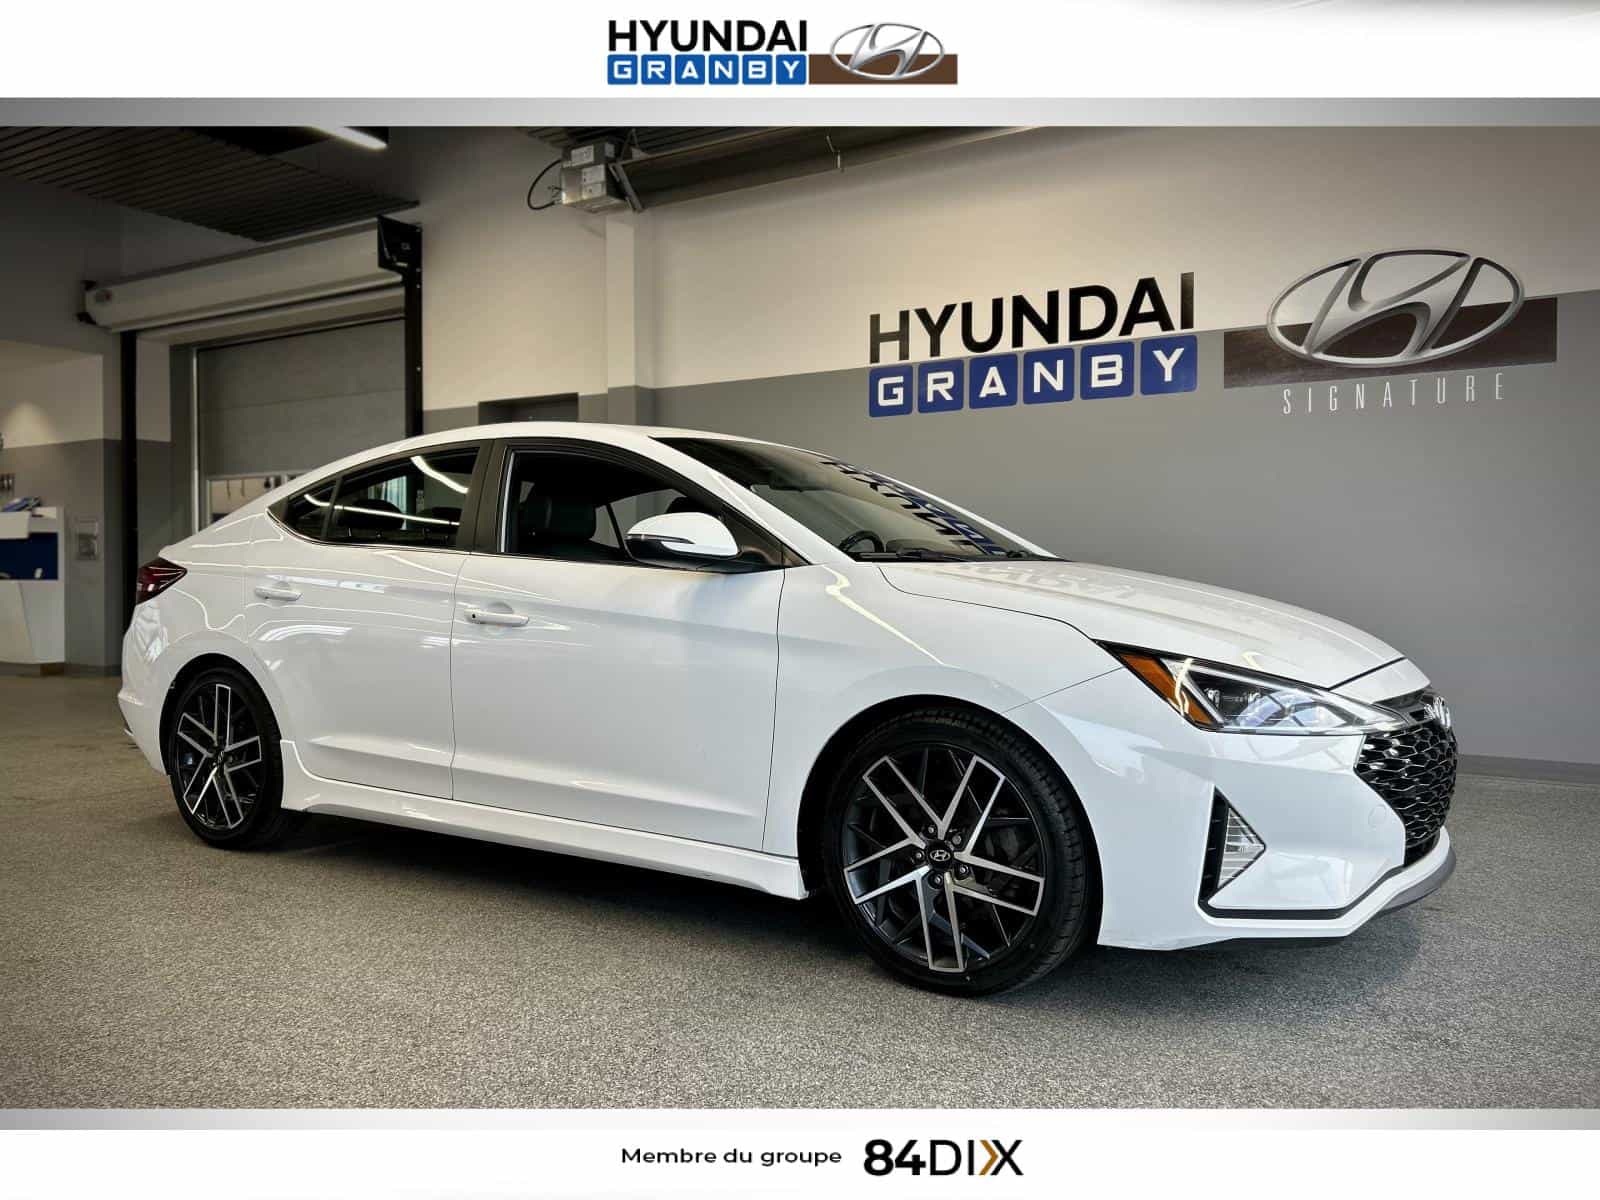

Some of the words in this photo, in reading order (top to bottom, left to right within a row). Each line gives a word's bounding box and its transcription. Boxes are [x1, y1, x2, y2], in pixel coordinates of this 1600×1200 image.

[869, 271, 1195, 364] HYUNDAI
[877, 347, 1185, 406] GRANBY
[1282, 372, 1504, 415] SIGNATURE
